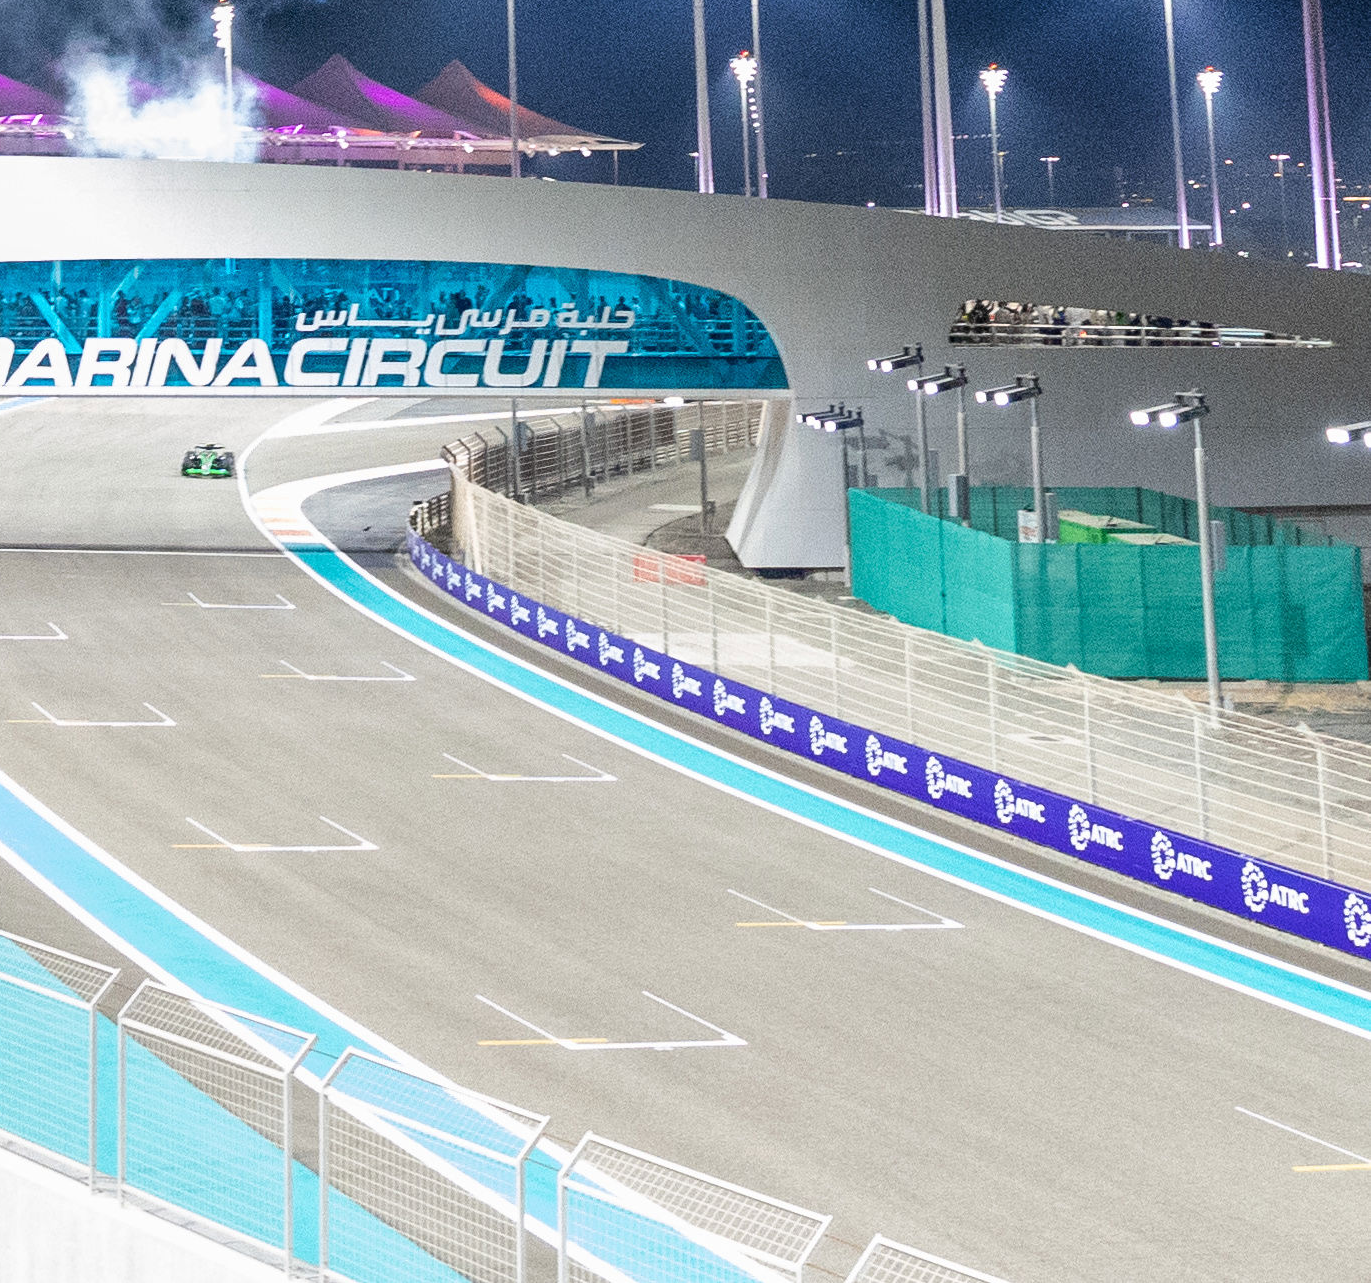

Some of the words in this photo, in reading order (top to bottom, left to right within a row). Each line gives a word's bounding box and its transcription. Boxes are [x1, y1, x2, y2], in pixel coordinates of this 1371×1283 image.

[556, 303, 636, 336] حلبة
[283, 337, 630, 388] CIRCUIT
[1015, 797, 1046, 823] ATRC
[1090, 823, 1124, 851] ATRC
[1176, 852, 1213, 881] ATRC
[1269, 883, 1310, 914] ATRC
